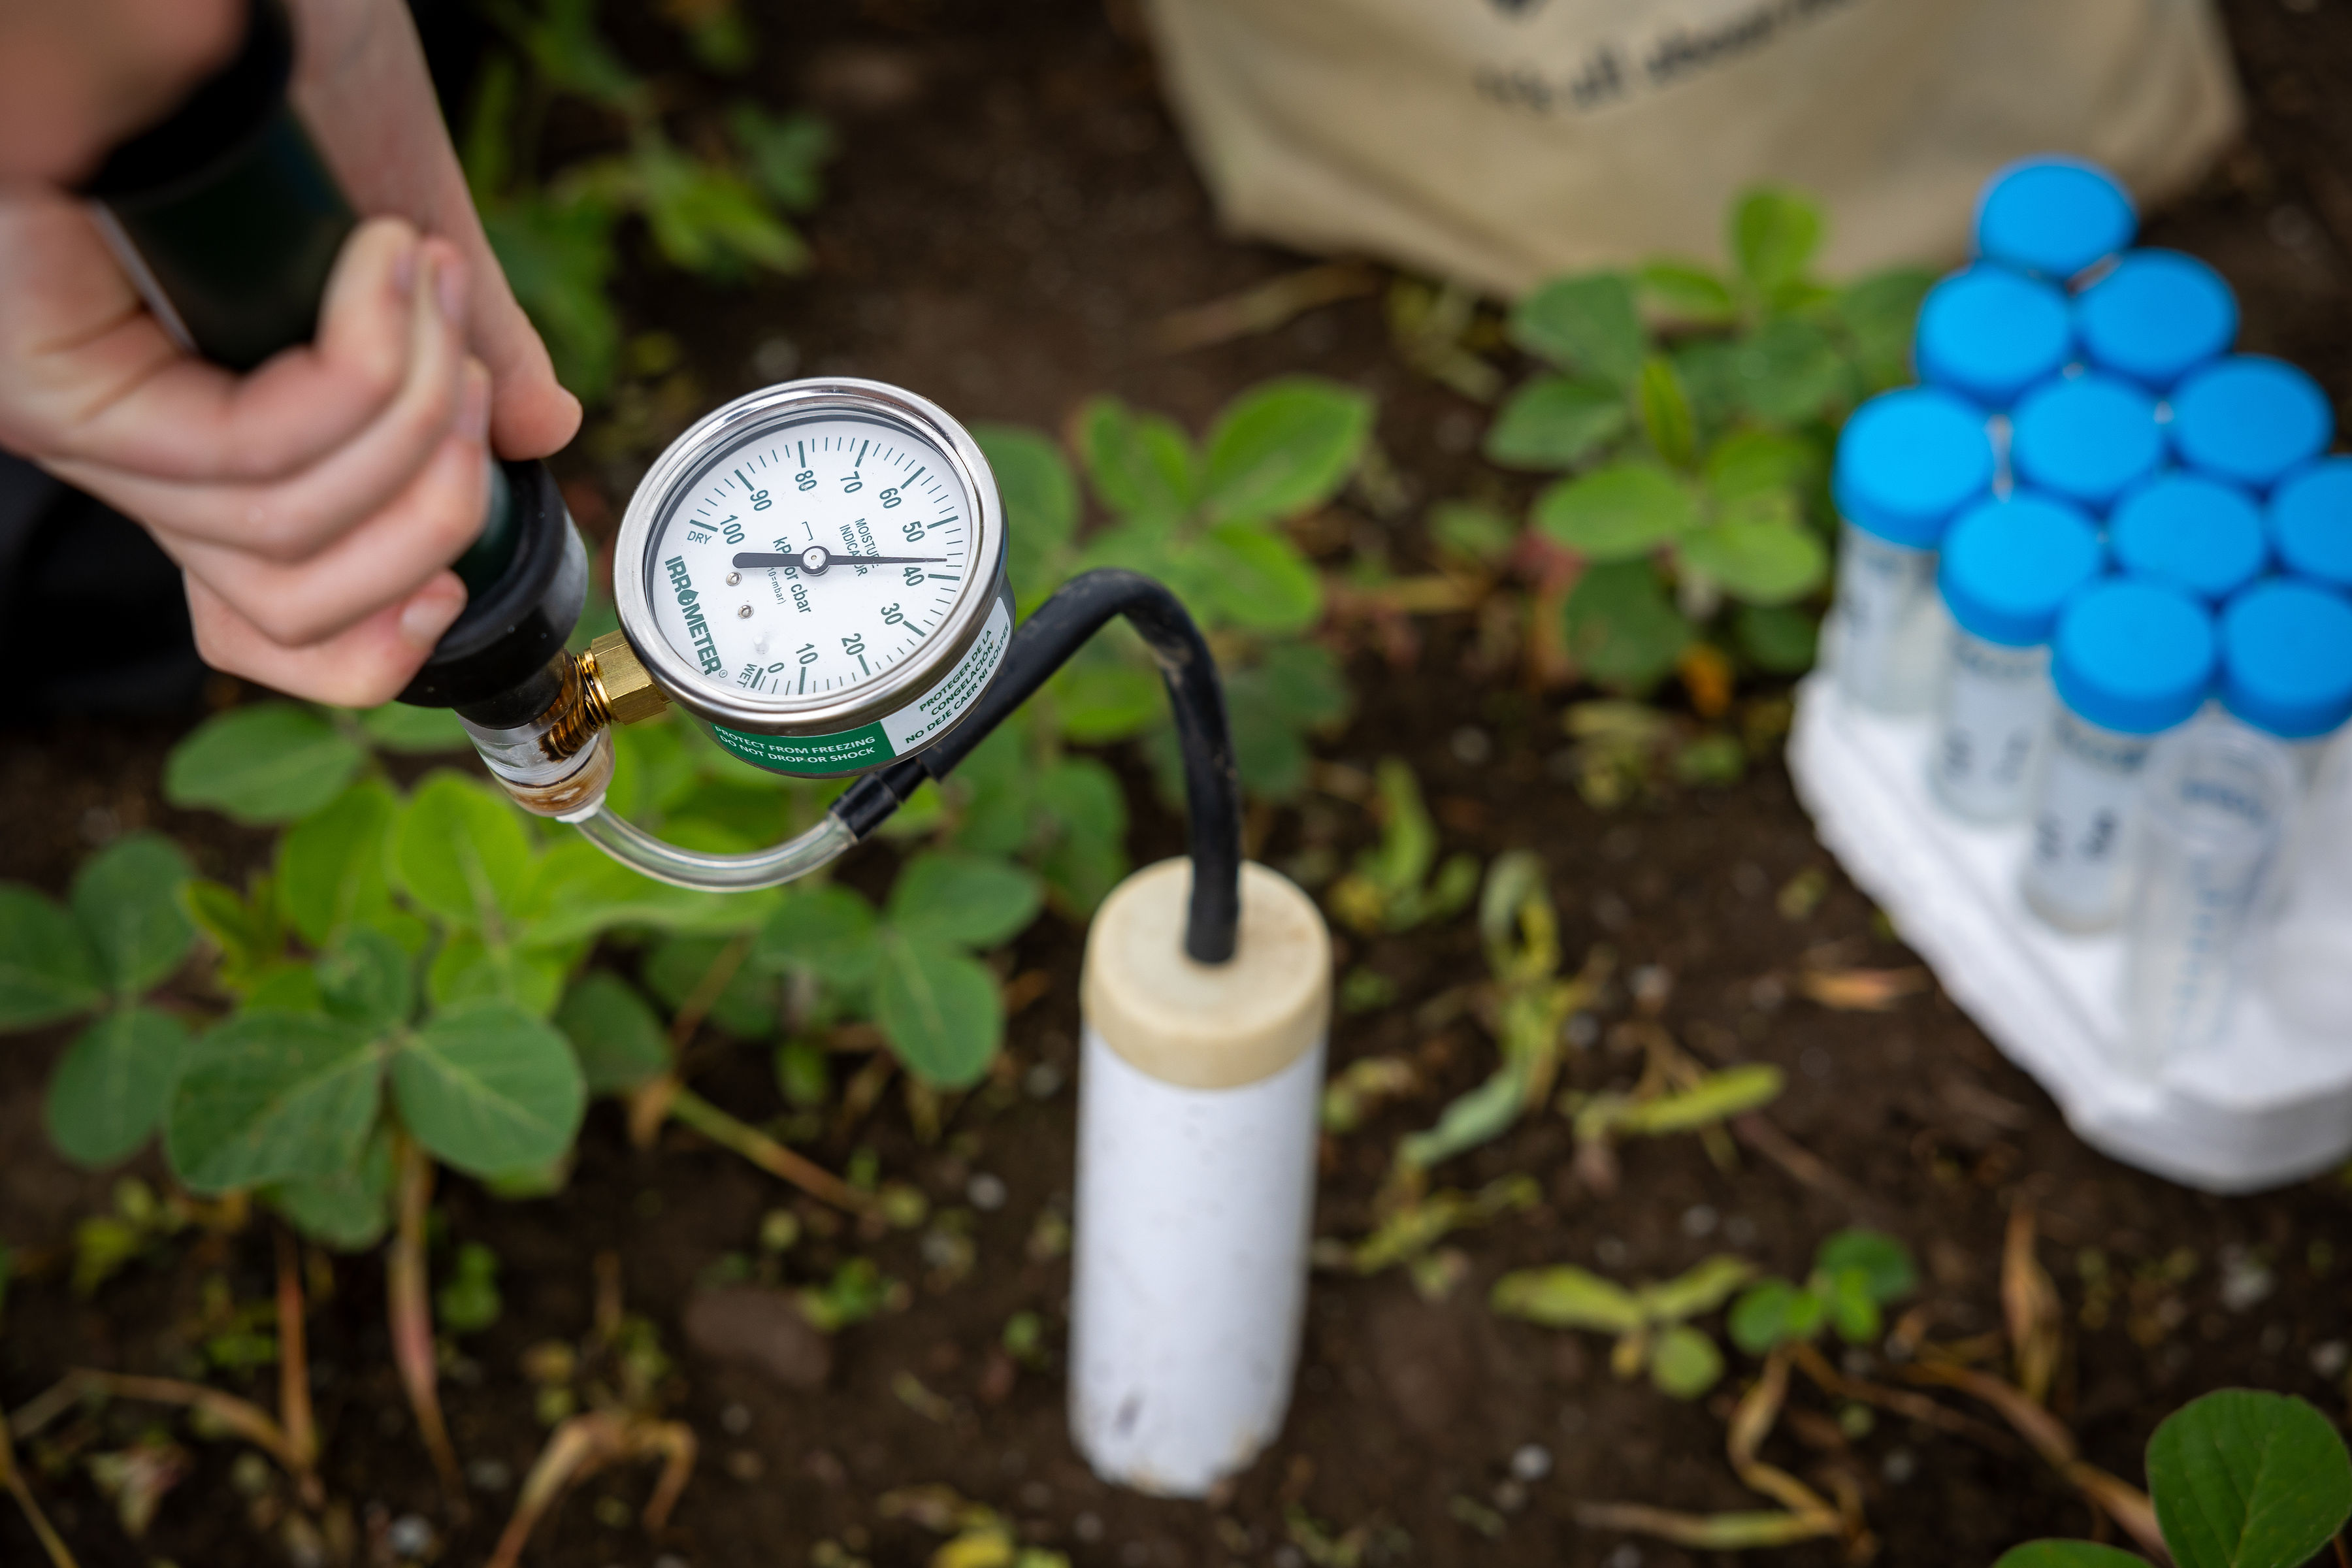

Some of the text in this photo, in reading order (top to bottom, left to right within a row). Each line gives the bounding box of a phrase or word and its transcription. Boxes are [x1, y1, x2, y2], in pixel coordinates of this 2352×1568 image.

[795, 470, 817, 491] 80
[840, 471, 862, 493] 70
[750, 489, 772, 512] 90
[879, 487, 902, 509] 60
[687, 531, 712, 545] DRY
[720, 515, 745, 544] 100
[902, 521, 925, 542] 50
[840, 524, 868, 576] INDICAR
[855, 518, 879, 568] MOISTU
[773, 536, 811, 613] kP or cbar
[903, 566, 924, 586] 40
[881, 602, 904, 625] 30
[796, 643, 818, 664] 10
[841, 633, 865, 655] 20
[737, 663, 757, 688] WET
[768, 662, 785, 674] 0
[919, 630, 992, 711] PROTEGER DE LA
[931, 642, 994, 715] CONGELACIÓN
[905, 622, 1009, 743] NO DEJE CAER NI GOLPEE
[715, 725, 875, 754] PROTECT FROM FREEZING
[720, 735, 736, 747] DO
[740, 744, 764, 757] NOT
[768, 753, 804, 763] DROP
[830, 747, 875, 762] SHOCK
